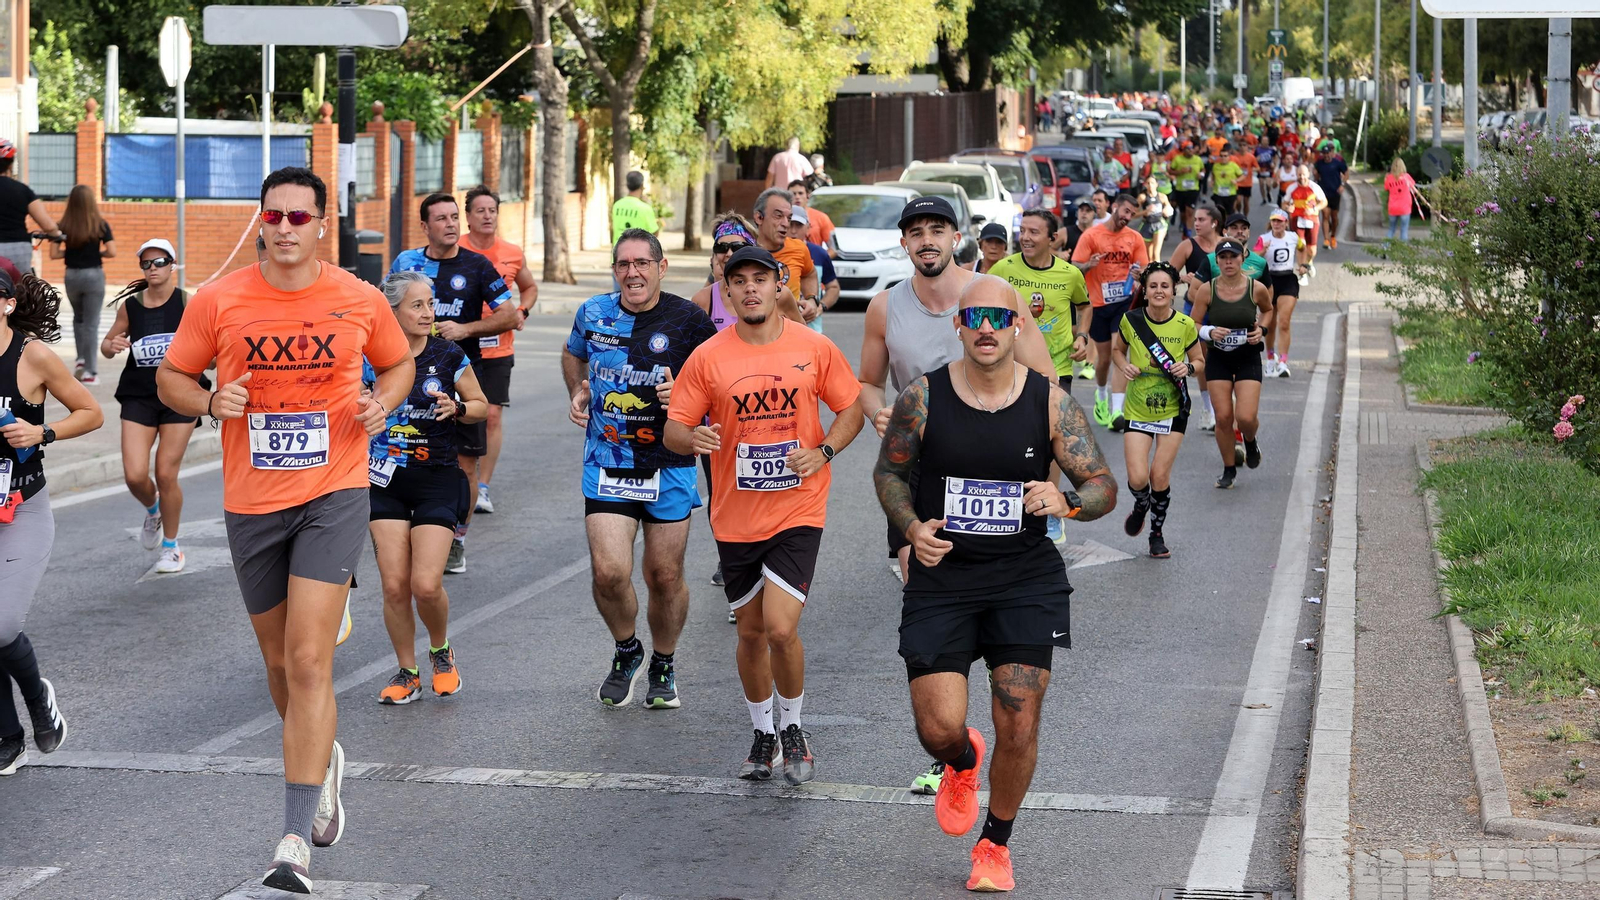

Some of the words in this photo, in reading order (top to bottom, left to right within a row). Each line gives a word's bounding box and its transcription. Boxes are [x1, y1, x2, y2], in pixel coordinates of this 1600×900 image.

[1008, 276, 1067, 290] Paparunners
[243, 333, 336, 361] XXIX
[247, 363, 274, 371] MEDIA
[276, 361, 321, 371] MARATÓN
[322, 361, 335, 369] DE
[618, 364, 665, 387] PUPAS
[731, 387, 799, 415] XXIX
[756, 411, 788, 421] MARATÓN
[269, 432, 309, 451] 879
[279, 455, 322, 467] MIZUNO
[751, 459, 785, 476] 909
[761, 478, 797, 489] MIZUNO
[621, 489, 654, 499] MIZUNO
[958, 497, 1010, 518] 1013
[971, 522, 1016, 532] MIZUNO
